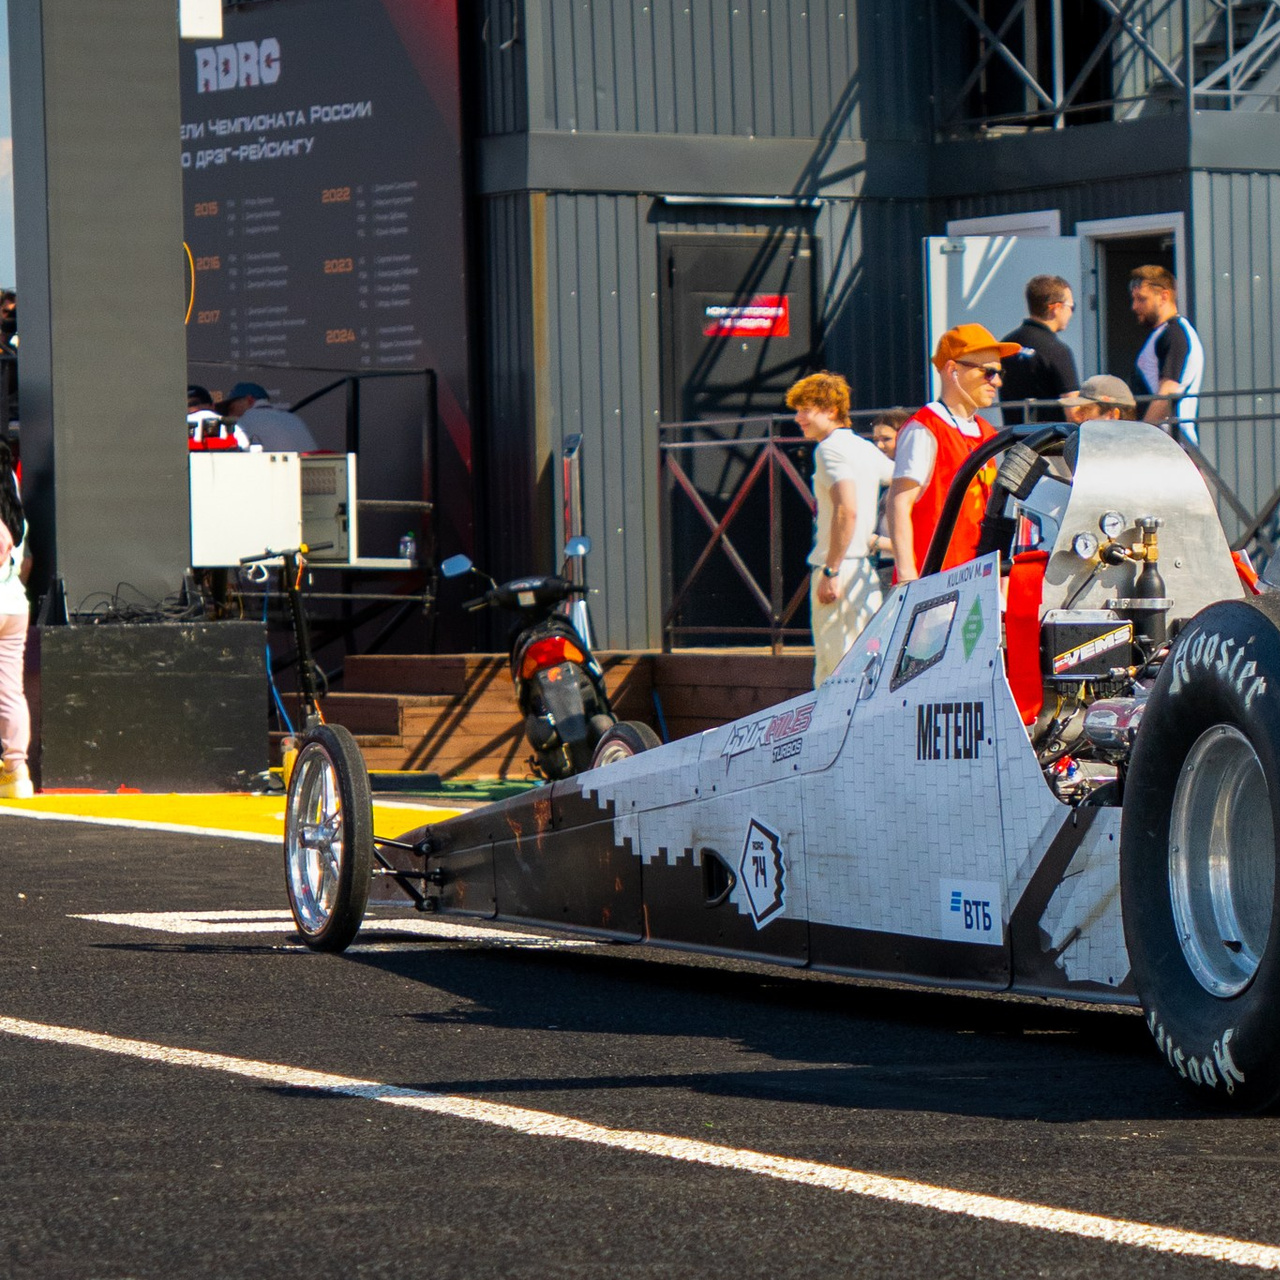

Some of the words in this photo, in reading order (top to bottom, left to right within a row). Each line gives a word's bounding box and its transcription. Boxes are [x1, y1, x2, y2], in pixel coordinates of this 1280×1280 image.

[195, 37, 281, 93] RDRC
[208, 109, 306, 137] ЧЕМПИОНАТА
[322, 186, 351, 203] 2022
[194, 201, 219, 217] 2015
[324, 257, 353, 274] 2023
[197, 309, 221, 324] 2017
[326, 327, 356, 344] 2024
[946, 564, 974, 589] KULIKOV
[1064, 626, 1131, 667] VEMS
[1168, 626, 1267, 711] Hoosier
[916, 701, 985, 761] МЕТЕОР
[772, 737, 803, 764] TURBOS
[752, 855, 767, 888] 74
[963, 899, 992, 931] ВТБ
